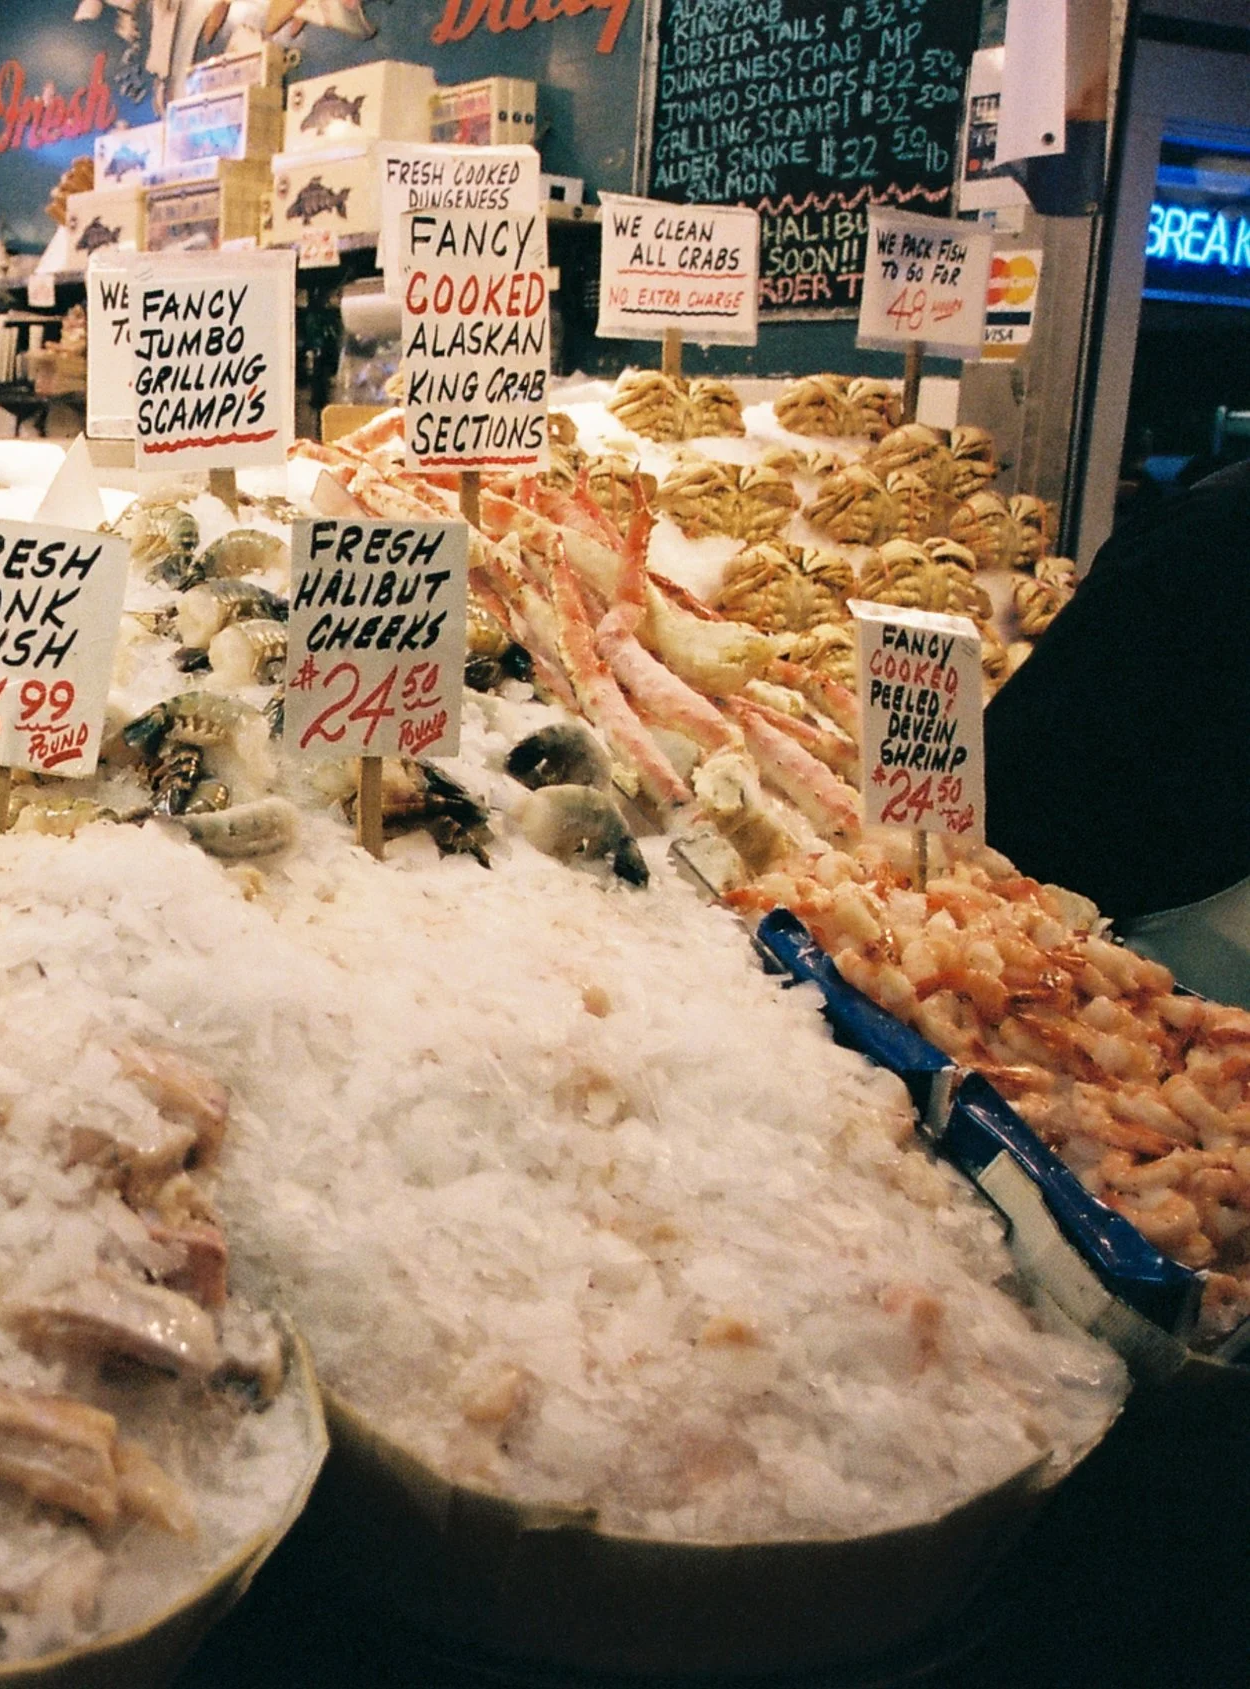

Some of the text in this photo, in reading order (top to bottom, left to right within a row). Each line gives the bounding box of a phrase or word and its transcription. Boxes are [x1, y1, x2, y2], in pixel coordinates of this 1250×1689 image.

[662, 29, 760, 70] LOBSTER
[762, 14, 826, 44] TAILS
[673, 11, 728, 45] KING
[662, 22, 922, 99] DUNGENESS CRAB MP
[658, 90, 738, 130] JUMBO
[743, 66, 859, 111] SCALLOPS
[753, 94, 849, 144] SCAMPI
[387, 159, 519, 185] FRESH COOKED
[654, 152, 719, 189] ALDER
[727, 140, 811, 177] SMOKE
[409, 187, 511, 211] DUNGENESS
[685, 172, 776, 204] SALMON
[411, 216, 535, 270] FANCY
[613, 213, 715, 243] WE CLEAN
[763, 211, 868, 248] HALIBU
[876, 228, 967, 264] WE PACK FISH
[630, 242, 740, 271] ALL CRABS
[765, 238, 858, 276] SOON!!
[881, 260, 961, 286] TO GO FOR
[142, 284, 248, 326] FANCY
[406, 271, 545, 318] COOKED
[608, 287, 745, 309] NO EXTRA CHARGE
[758, 273, 831, 305] RDER
[886, 287, 926, 331] 48
[135, 326, 244, 360] JUMBO
[407, 318, 546, 358] ALASKAN
[984, 328, 1014, 342] VISA
[135, 354, 267, 396] GRILLING
[408, 367, 546, 405] KING CRAB
[412, 413, 545, 455] SECTIONS
[310, 521, 445, 566] FRESH
[293, 567, 450, 611] HALIBUT
[306, 610, 447, 652] CHEEKS
[882, 623, 955, 671] FANCY
[869, 648, 958, 694] COOKED
[870, 679, 939, 718] PEELED
[28, 722, 88, 762] POUND
[887, 711, 958, 745] DEVEIN
[880, 738, 967, 773] SHRIMP
